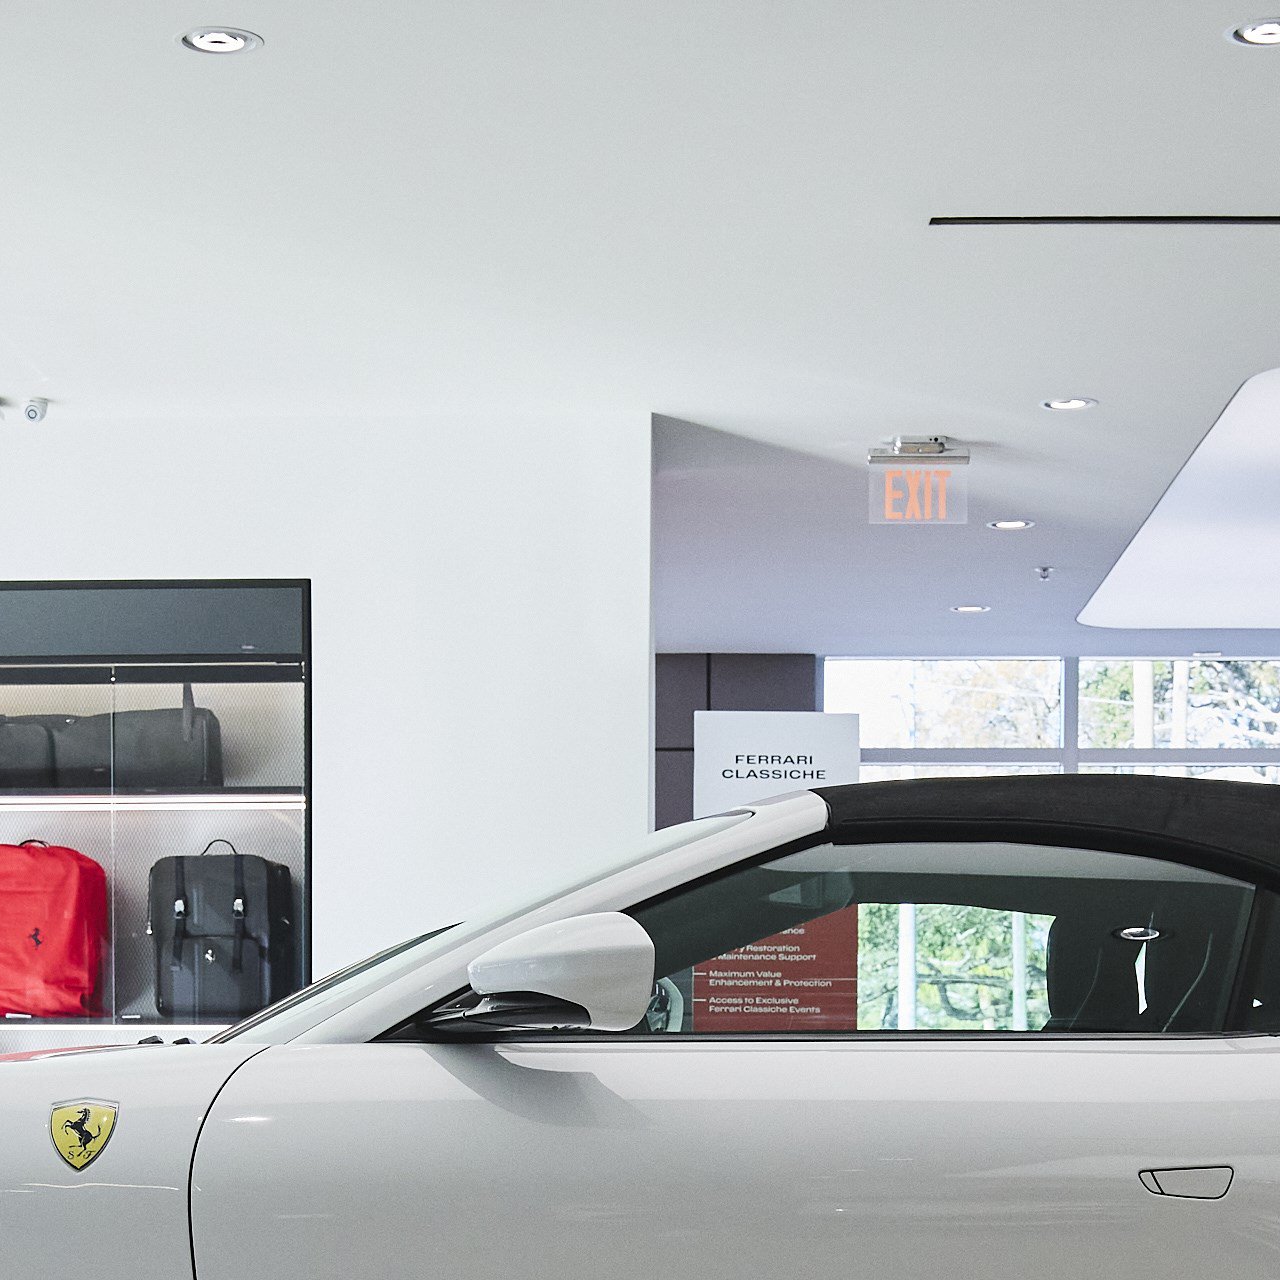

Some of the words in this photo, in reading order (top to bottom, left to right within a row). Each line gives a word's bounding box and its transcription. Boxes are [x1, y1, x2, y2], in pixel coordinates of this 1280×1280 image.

[884, 469, 952, 520] EXIT
[735, 754, 813, 765] FERRARI
[721, 769, 826, 780] CLASSICHE
[746, 944, 800, 952] Restoration
[778, 953, 816, 962] Support
[709, 970, 755, 978] Maximum
[756, 970, 782, 978] Value
[709, 979, 773, 987] Enhancement
[774, 979, 782, 987] &
[783, 979, 832, 987] Protection
[709, 996, 743, 1004] Access
[756, 996, 799, 1005] Exclusive
[709, 1005, 742, 1013] Ferrari
[743, 1005, 788, 1013] Classiche
[789, 1005, 821, 1014] Events
